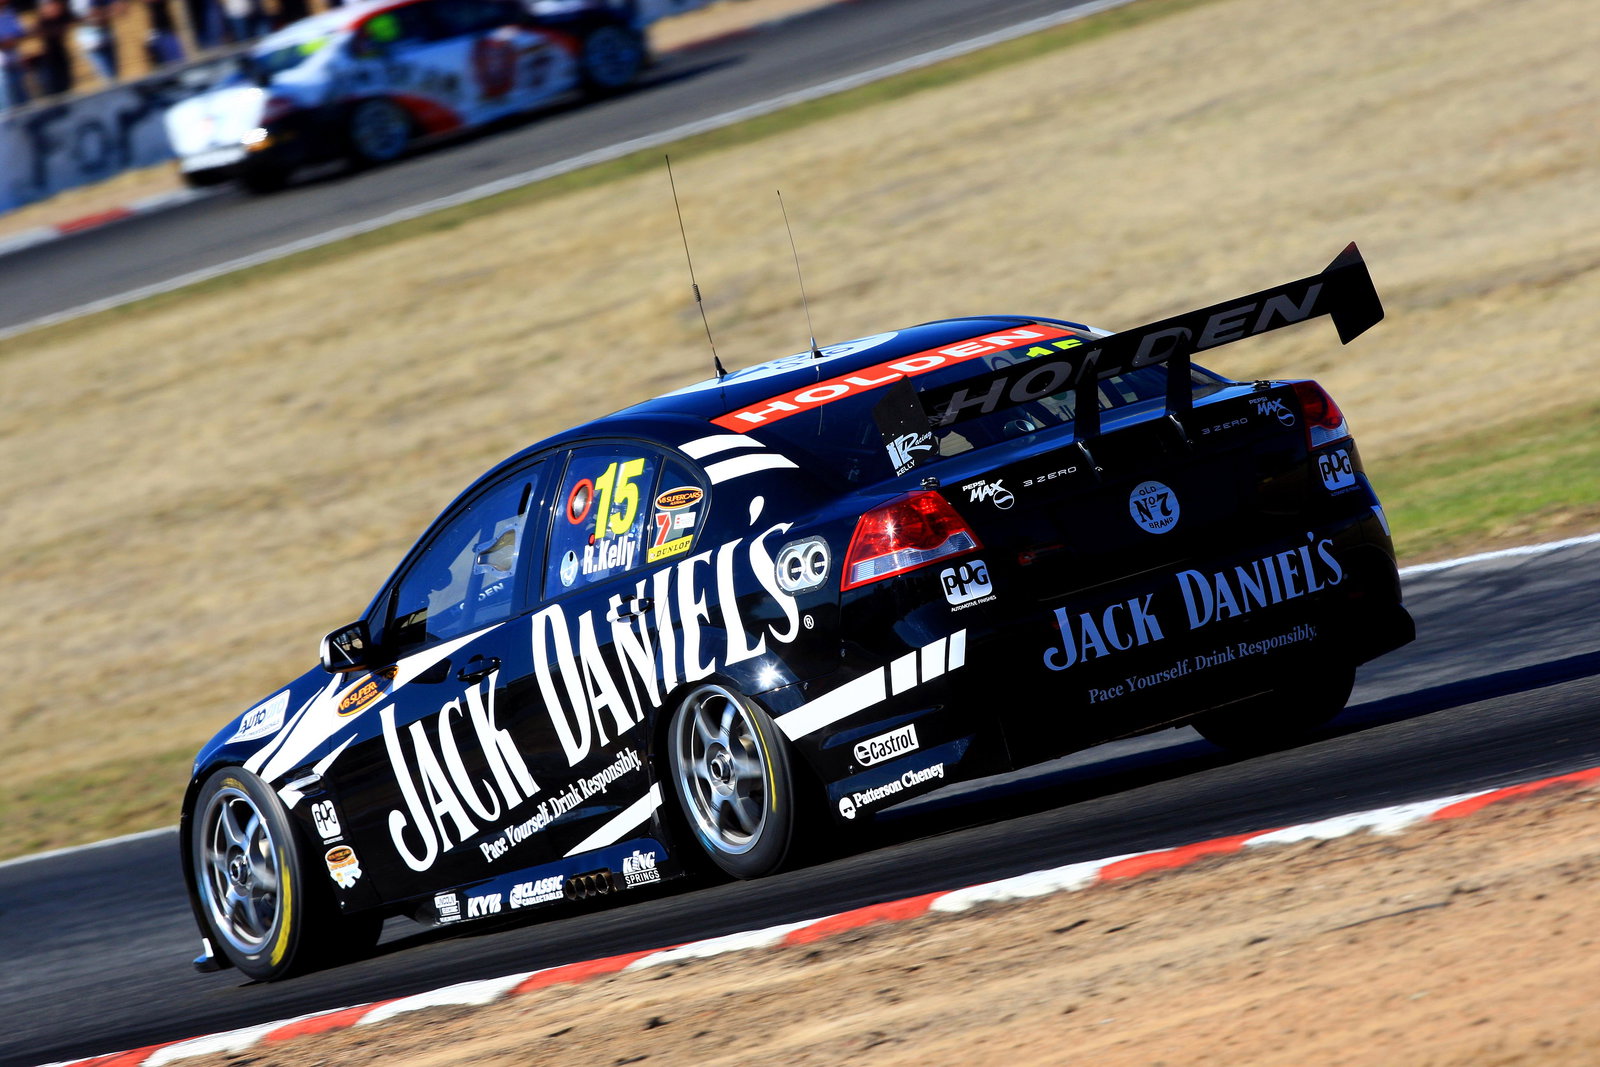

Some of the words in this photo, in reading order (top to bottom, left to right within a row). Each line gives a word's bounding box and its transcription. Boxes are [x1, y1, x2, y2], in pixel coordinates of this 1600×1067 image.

[734, 329, 1045, 424] HOLDEN
[1248, 396, 1268, 405] PEPSI
[1257, 398, 1282, 416] MAX
[896, 460, 916, 477] KELLY
[1036, 466, 1078, 483] ZERO
[961, 479, 986, 492] PEPSI
[969, 478, 1005, 503] MAX
[1138, 486, 1157, 496] OLD
[594, 457, 646, 540] 15
[1148, 516, 1174, 529] BRAND
[656, 540, 691, 558] DUNLOP
[942, 563, 990, 597] PPG
[1043, 592, 1165, 671] JACK
[1175, 531, 1344, 630] DANIEL'S
[1088, 684, 1125, 705] Pace
[1125, 658, 1193, 693] Yourself.
[1195, 645, 1236, 671] Drink
[1238, 623, 1318, 655] Responsibly.
[379, 669, 541, 873] JACK
[531, 495, 800, 767] DANIEL'S
[869, 729, 915, 760] Castrol
[852, 779, 904, 808] Patterson
[901, 762, 944, 788] Cheney
[479, 834, 509, 863] Pace
[504, 801, 554, 847] Yourself.
[548, 783, 584, 818] Drink
[577, 747, 642, 800] Responsibly.
[622, 850, 656, 874] KING
[521, 874, 564, 898] CLASSIC
[624, 870, 660, 885] SPRINGS
[467, 893, 502, 918] KYB
